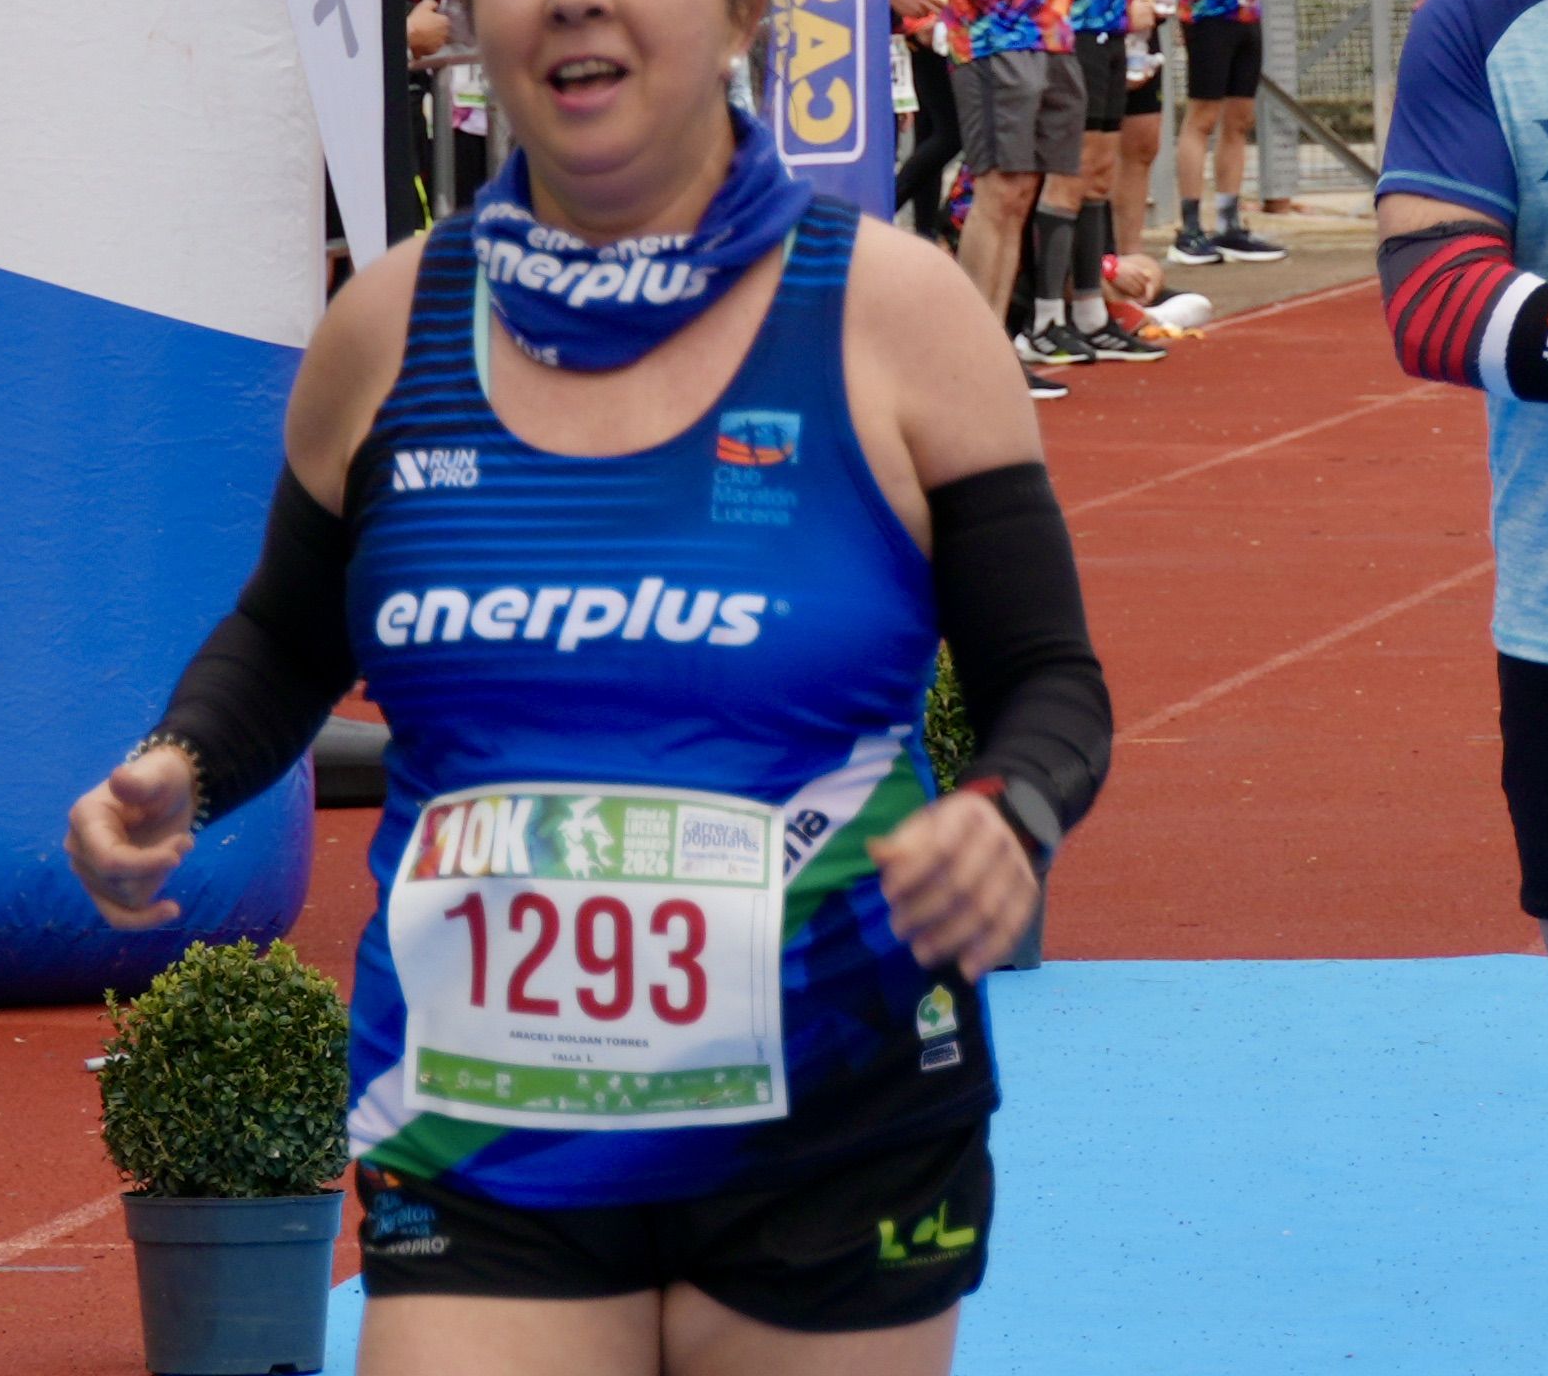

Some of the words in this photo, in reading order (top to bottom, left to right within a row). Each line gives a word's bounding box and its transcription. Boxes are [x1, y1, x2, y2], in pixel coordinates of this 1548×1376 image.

[474, 236, 718, 309] enerplus
[429, 448, 478, 469] RUN
[429, 466, 480, 489] PRO
[376, 578, 767, 652] enerplus
[438, 797, 533, 875] 10K
[443, 890, 708, 1026] 1293
[605, 1036, 649, 1049] TORRES
